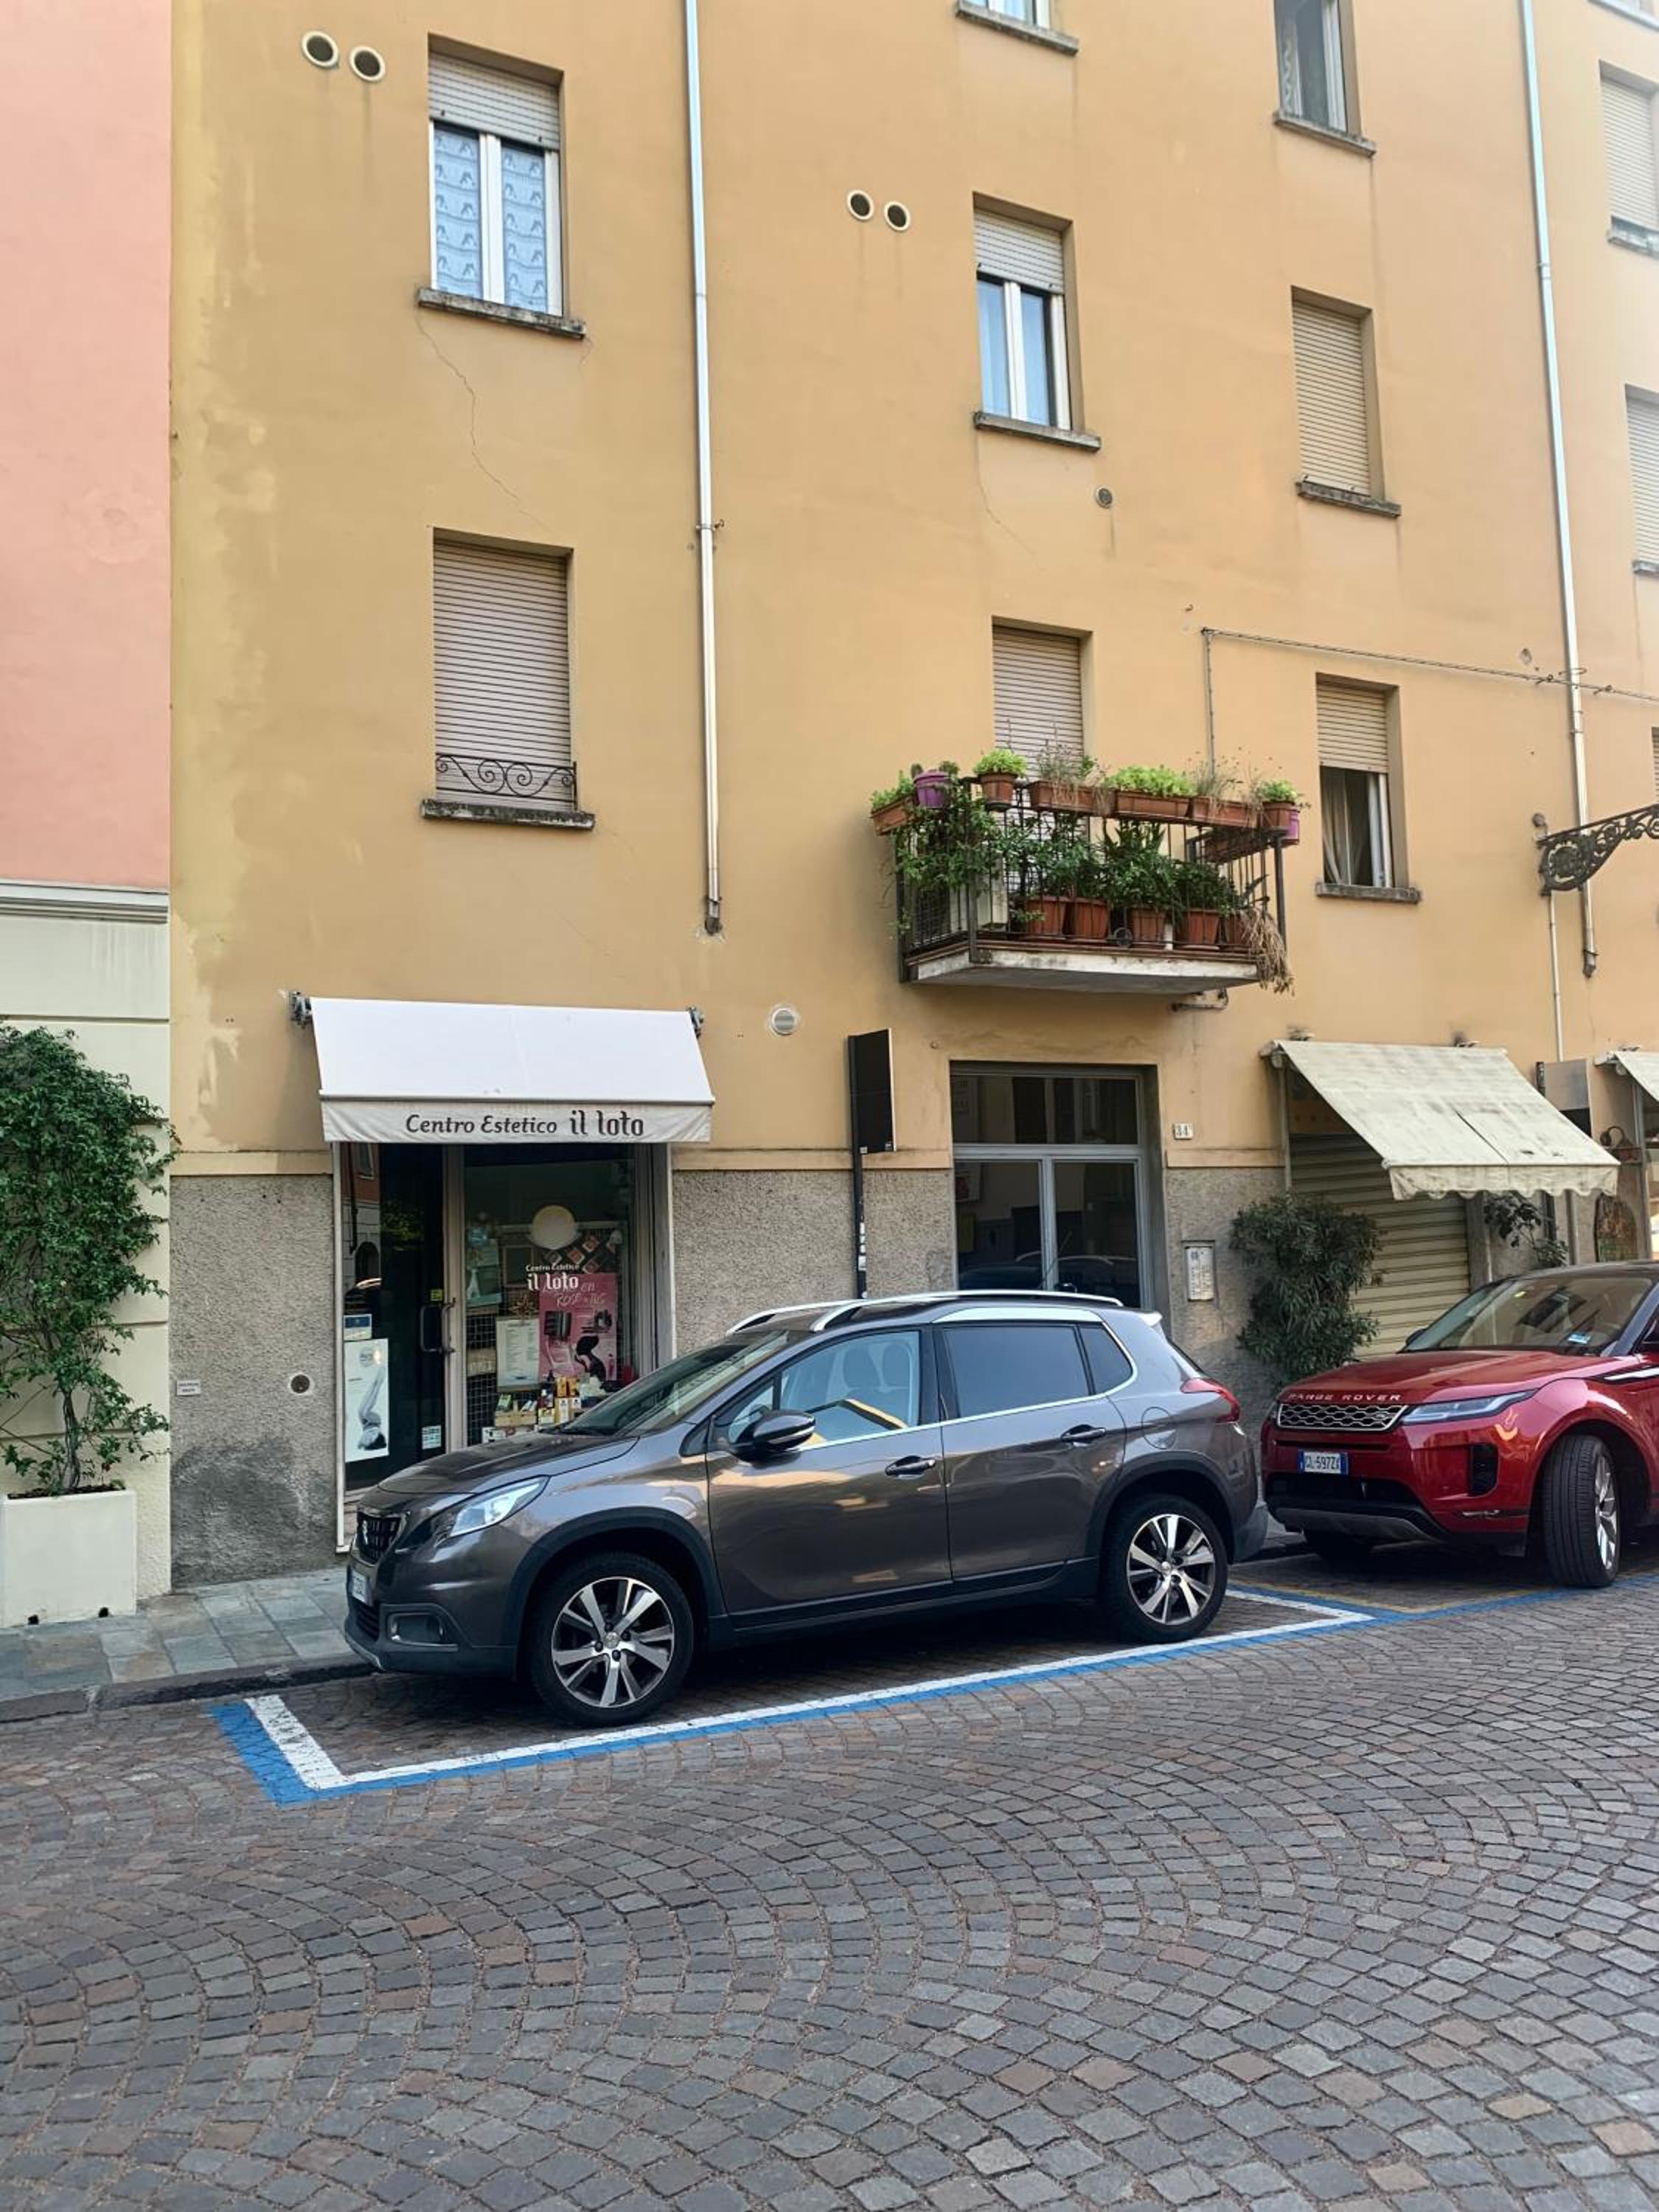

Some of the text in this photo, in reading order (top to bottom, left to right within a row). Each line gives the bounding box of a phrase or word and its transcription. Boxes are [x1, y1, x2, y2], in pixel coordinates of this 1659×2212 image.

[406, 1110, 644, 1136] Centro Estetico il loto
[527, 1273, 540, 1290] il
[545, 1272, 579, 1290] loto
